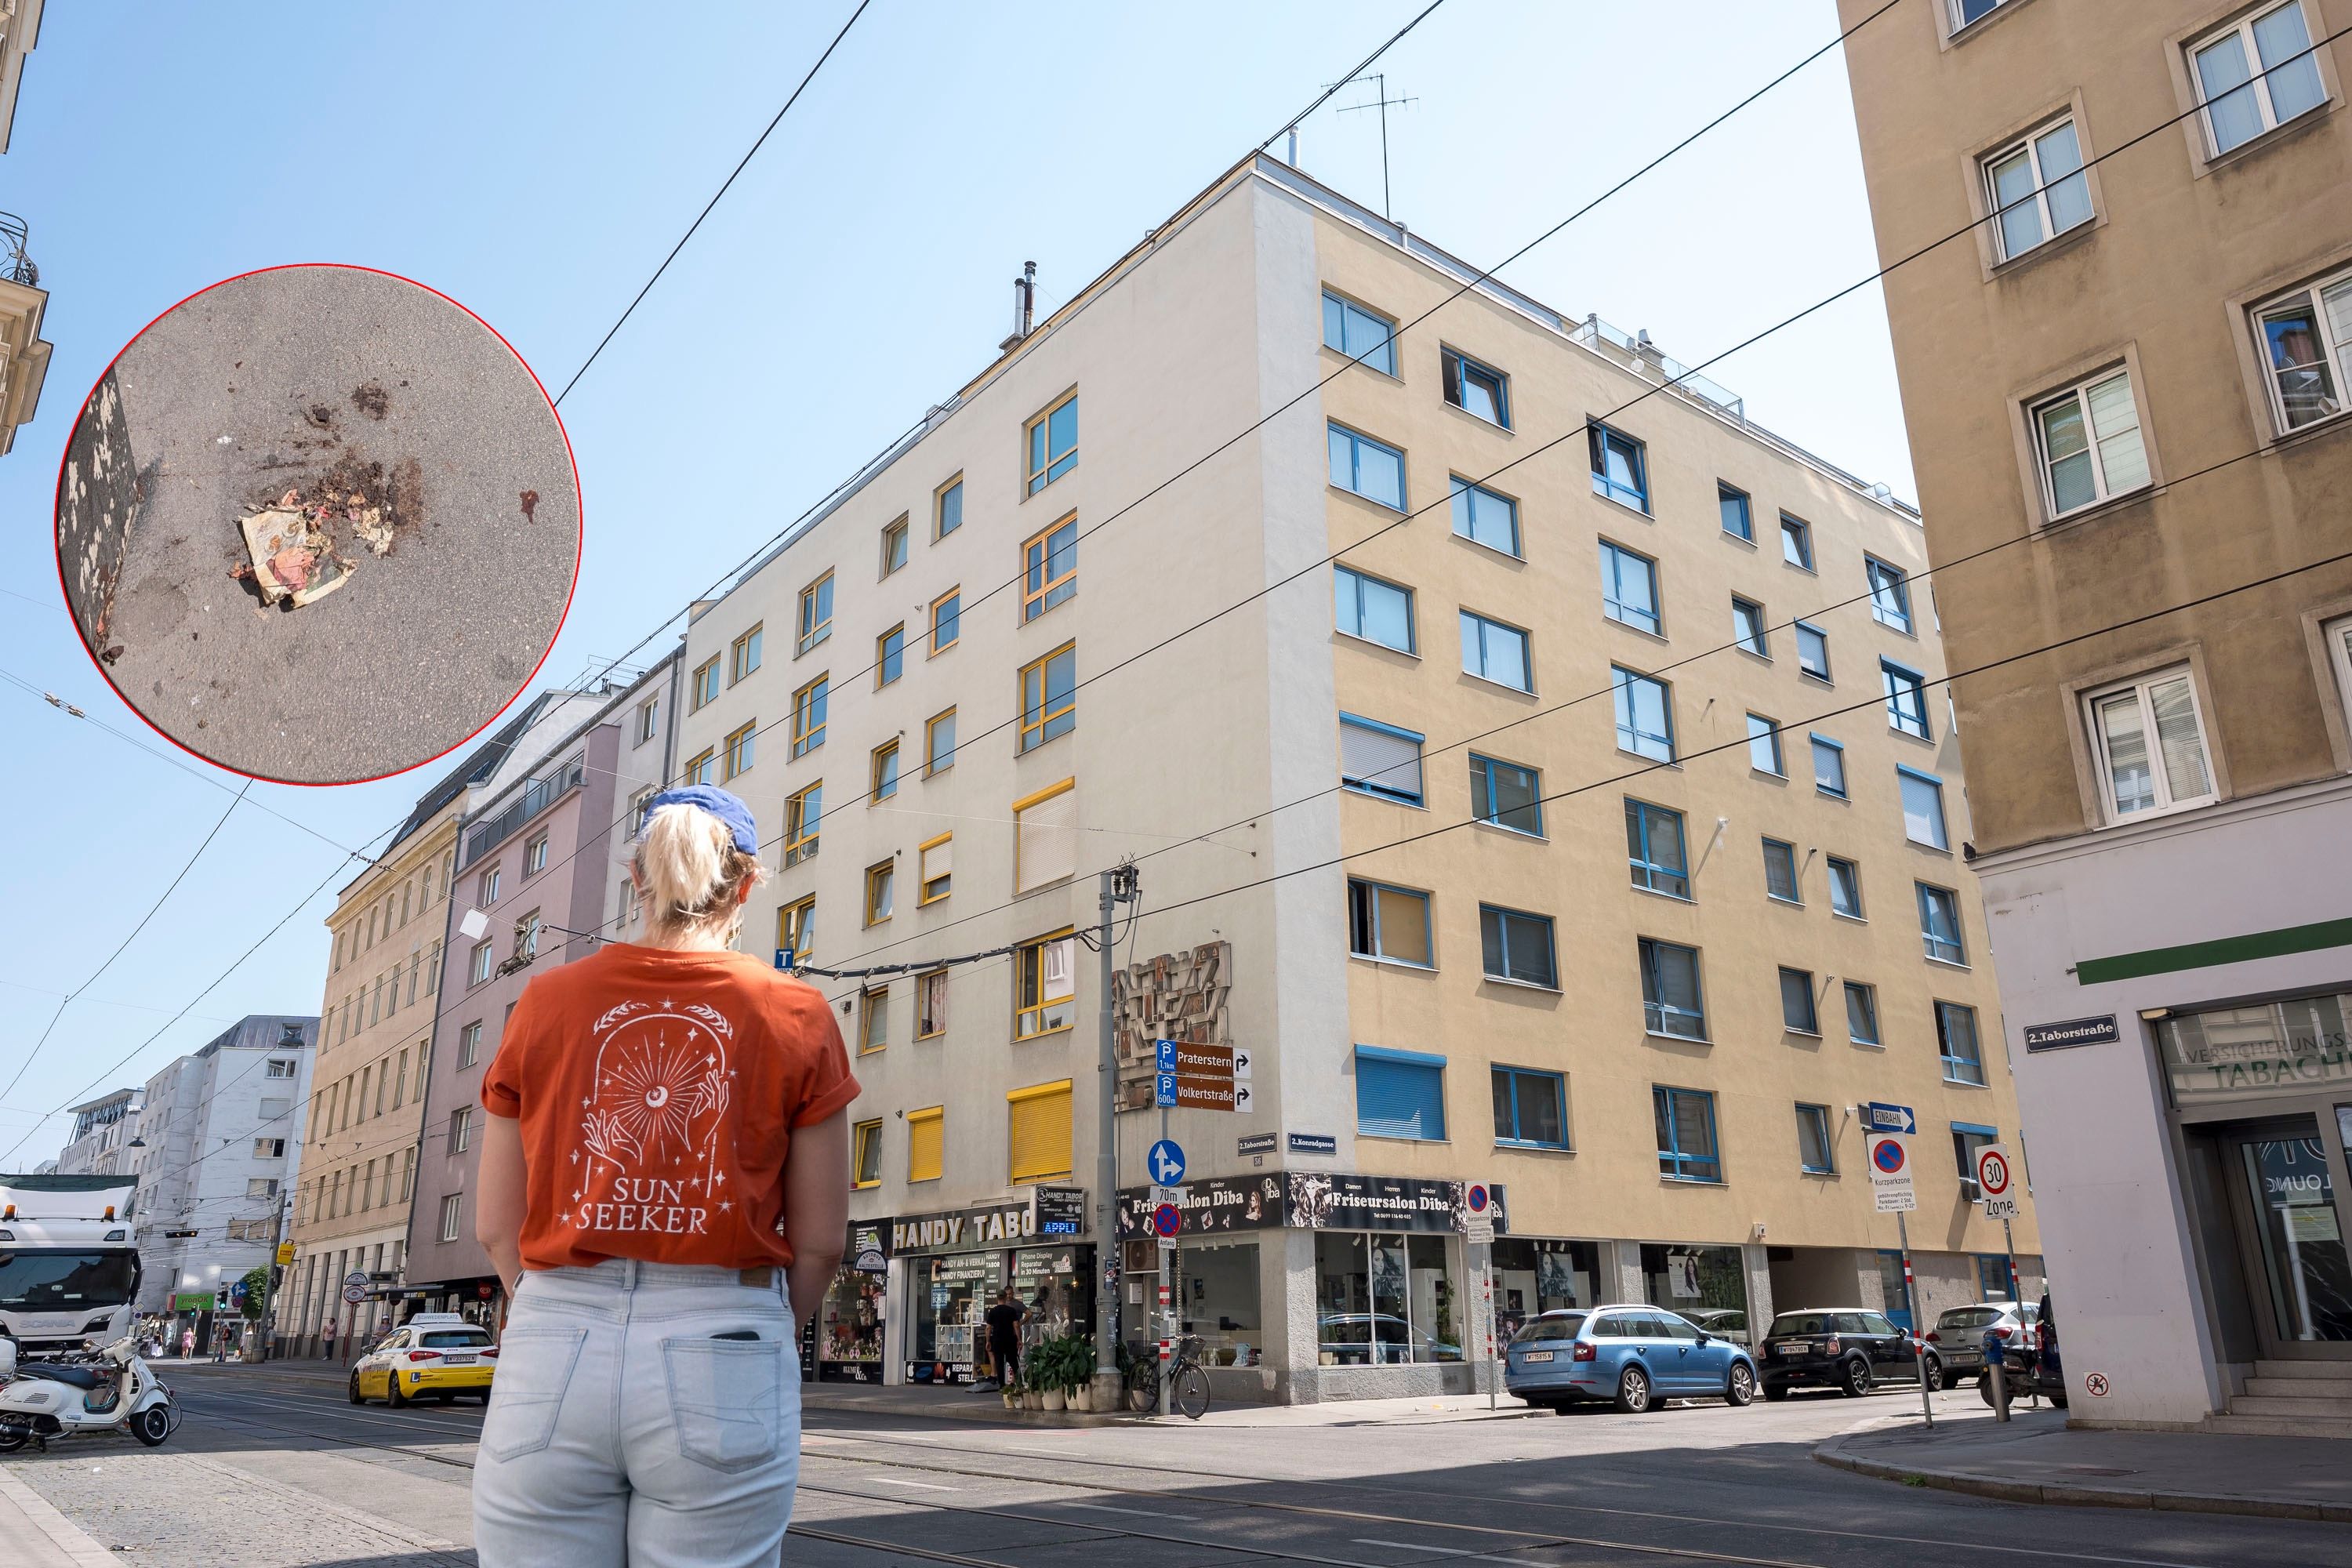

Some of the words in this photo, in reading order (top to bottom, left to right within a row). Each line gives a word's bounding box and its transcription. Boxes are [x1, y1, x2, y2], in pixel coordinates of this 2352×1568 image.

[779, 951, 791, 967] T
[2186, 1032, 2352, 1063] VERSICHERUNGS
[1178, 1051, 1232, 1067] Praterstern
[2208, 1051, 2352, 1088] TABACH
[1178, 1086, 1233, 1102] Volkertstraße
[1875, 1111, 1901, 1125] EINBAHN
[1986, 1162, 2002, 1184] 30
[1875, 1178, 1911, 1186] Kurzparkzone
[612, 1178, 684, 1204] SUN
[1213, 1191, 1244, 1206] Diba
[1333, 1192, 1417, 1210] Friseursalon
[1420, 1196, 1449, 1210] Diba
[1985, 1199, 2013, 1215] Zone
[575, 1203, 707, 1235] SEEKER
[893, 1218, 964, 1249] HANDY
[974, 1210, 1033, 1242] TABO
[1160, 1239, 1175, 1248] Anfang
[941, 1259, 956, 1269] HANDY
[1021, 1261, 1043, 1269] Reparatur
[941, 1271, 956, 1280] HANDY
[18, 1319, 76, 1328] SCANIA
[952, 1363, 973, 1372] REPARA
[957, 1374, 977, 1382] STELL
